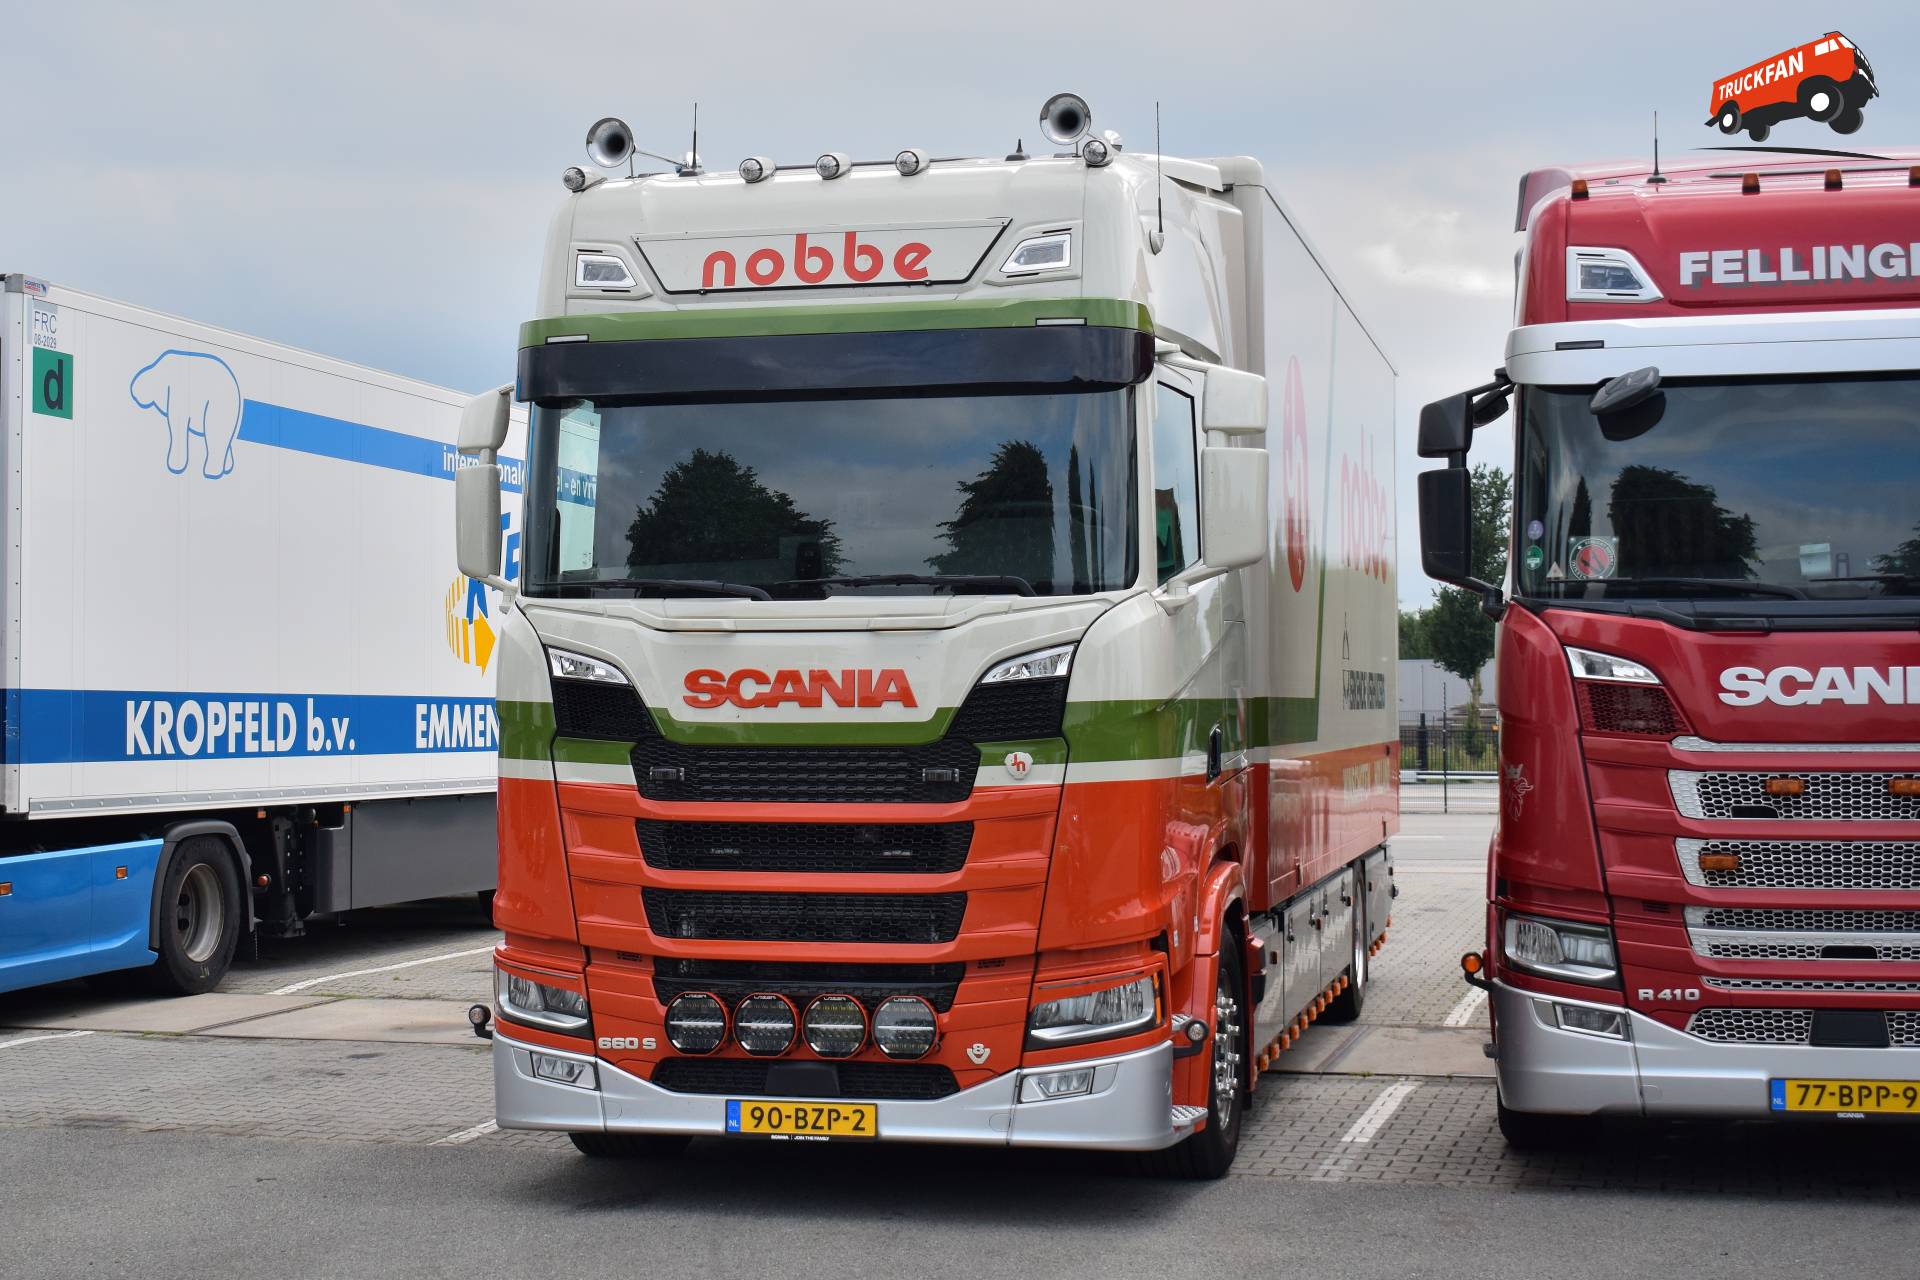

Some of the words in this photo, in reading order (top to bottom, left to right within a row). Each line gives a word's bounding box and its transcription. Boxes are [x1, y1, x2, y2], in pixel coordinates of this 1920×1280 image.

[701, 231, 932, 288] nobbe
[34, 310, 57, 334] FRC
[43, 358, 64, 410] d
[682, 668, 919, 709] SCANIA
[126, 699, 297, 756] KROPFELD
[307, 698, 356, 752] b.v.
[1637, 988, 1655, 1001] R
[1656, 988, 1700, 1001] 410
[598, 1036, 639, 1050] 660
[642, 1037, 657, 1050] S
[1773, 1097, 1784, 1105] NL
[1796, 1084, 1918, 1108] 77-BPP-9
[728, 1119, 739, 1127] NL
[750, 1106, 866, 1131] 90-BZP-2
